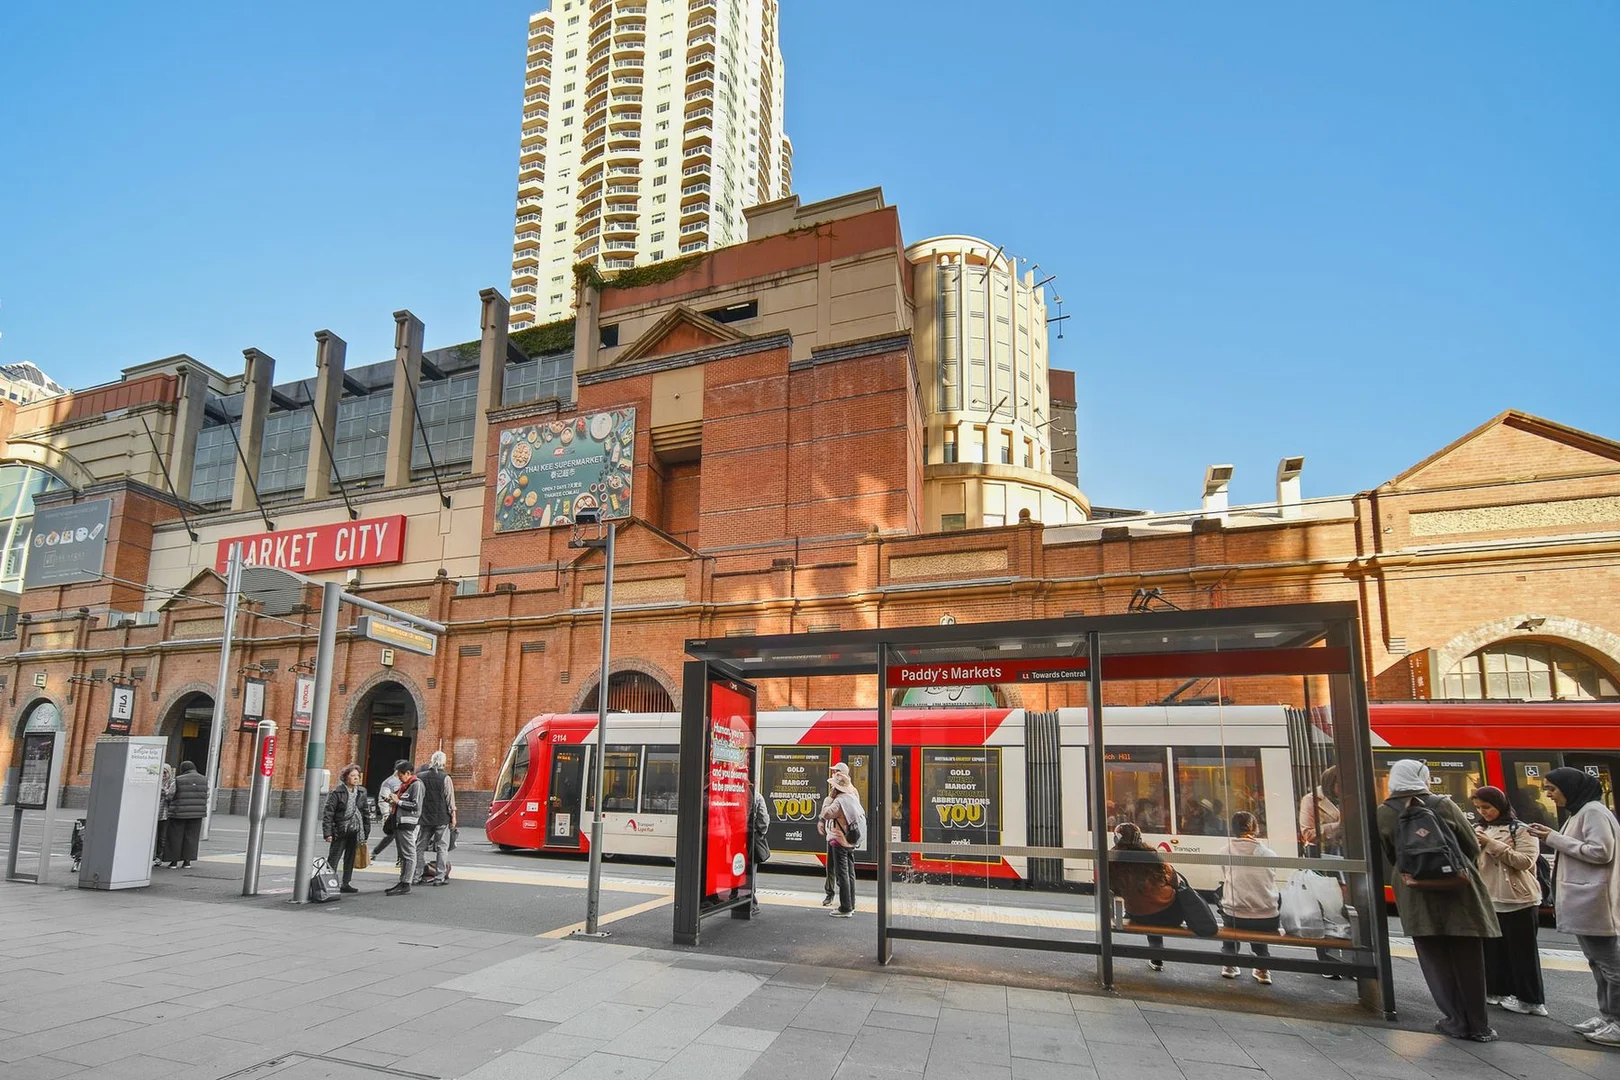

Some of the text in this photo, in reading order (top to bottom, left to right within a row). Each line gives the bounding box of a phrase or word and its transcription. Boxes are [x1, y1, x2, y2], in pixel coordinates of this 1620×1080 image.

[525, 455, 604, 474] THAI KEE SUPERMARKET
[335, 522, 389, 562] CITY
[383, 650, 392, 663] F
[36, 674, 44, 685] E
[901, 666, 1002, 683] Paddy's Markets
[1032, 671, 1060, 679] Towards
[1061, 670, 1087, 678] Central
[118, 694, 128, 714] FILA
[552, 734, 567, 742] 2114
[718, 781, 724, 791] be
[931, 797, 990, 805] ABBREVIATIONS
[773, 798, 815, 818] YOU
[936, 804, 984, 825] YOU
[1173, 845, 1200, 853] Transport
